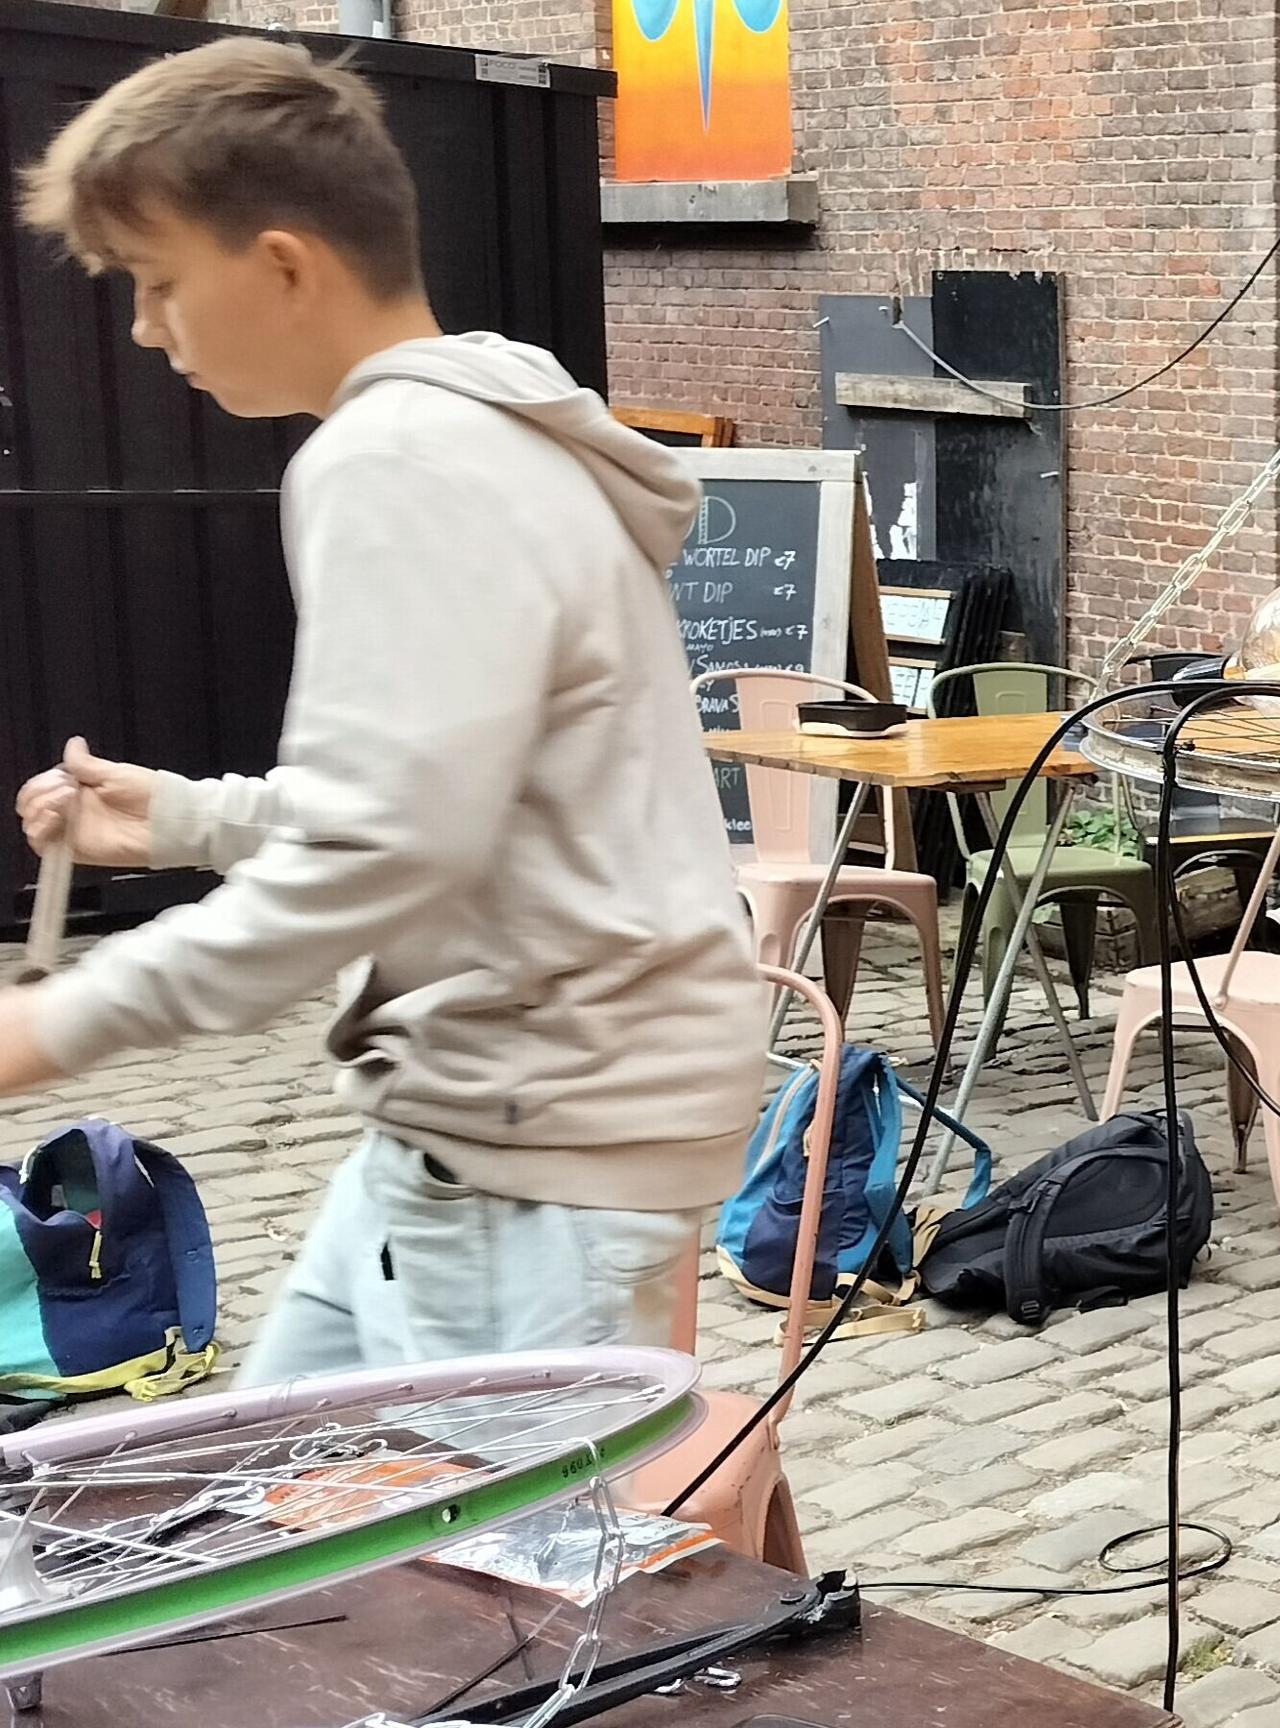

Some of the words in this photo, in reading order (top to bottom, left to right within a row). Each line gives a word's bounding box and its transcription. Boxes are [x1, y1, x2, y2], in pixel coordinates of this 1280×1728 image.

[683, 547, 740, 568] WORTEL
[744, 546, 772, 567] DIP
[703, 581, 734, 603] DIP
